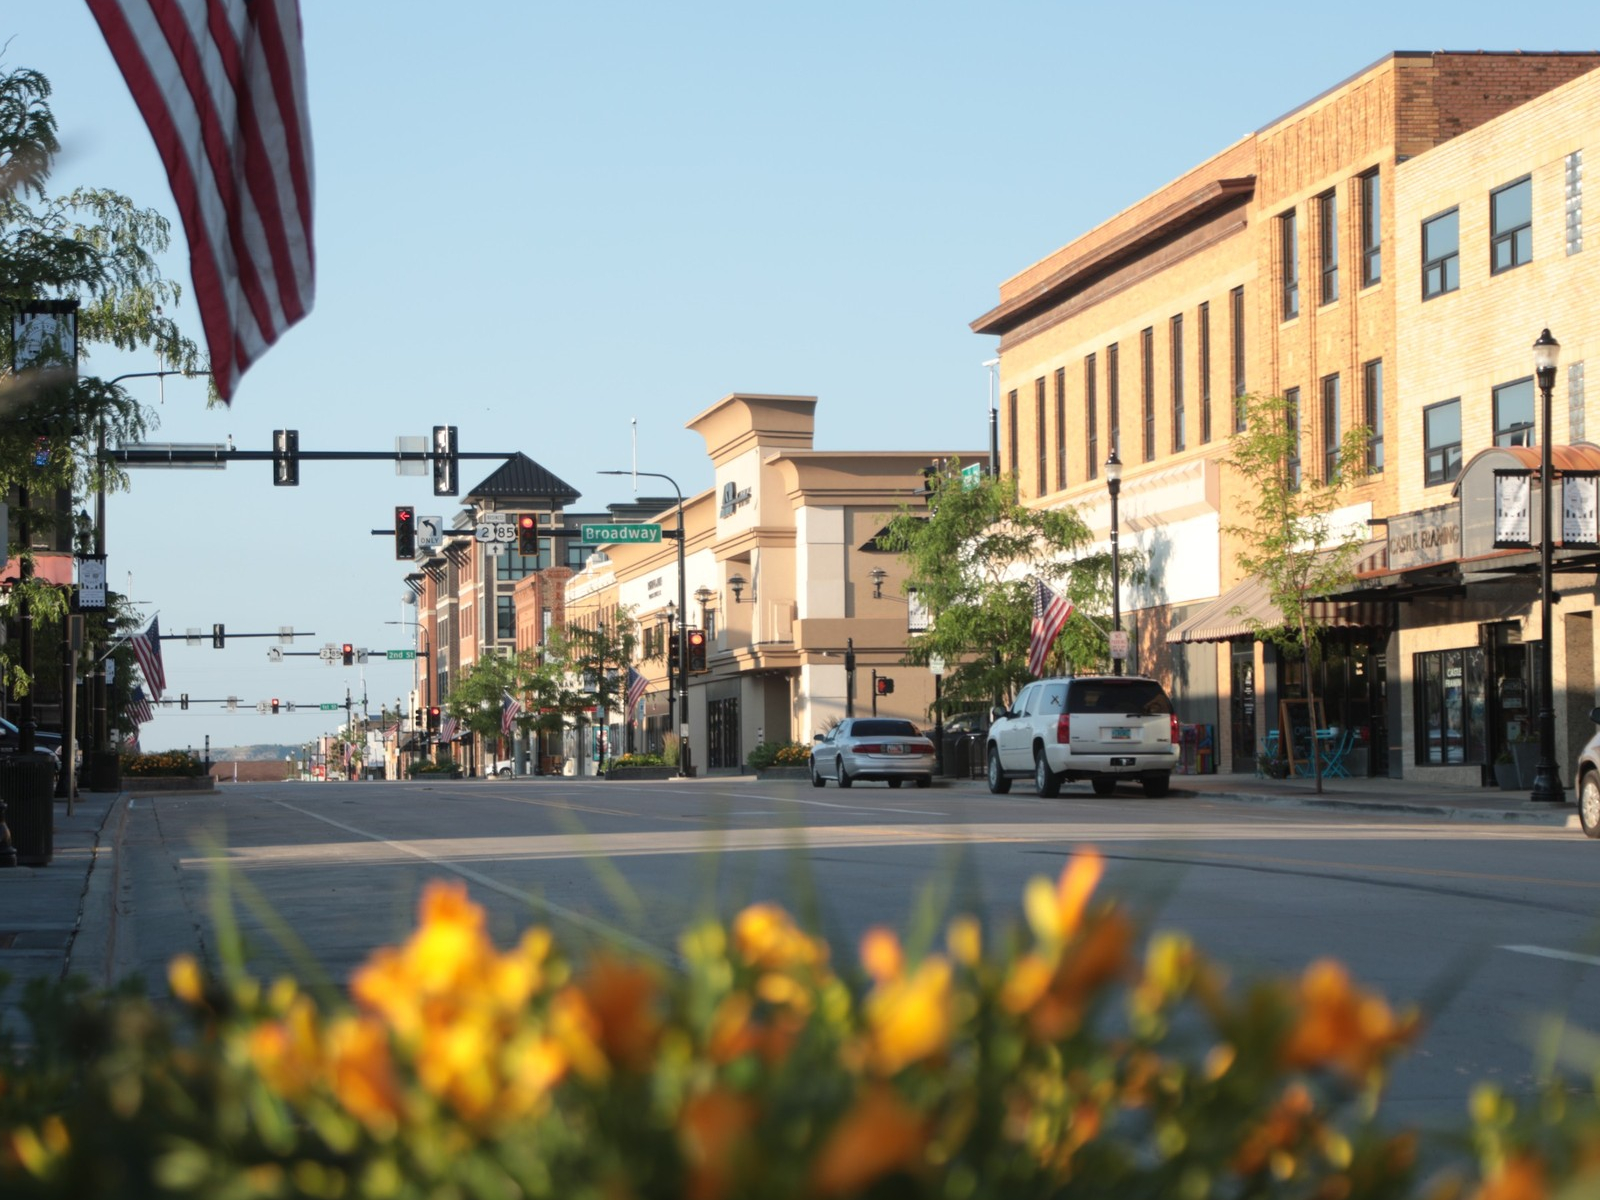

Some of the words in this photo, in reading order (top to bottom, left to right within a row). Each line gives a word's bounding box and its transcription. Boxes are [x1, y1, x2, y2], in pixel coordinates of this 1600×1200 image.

[481, 527, 489, 538] 2
[498, 527, 514, 538] 85
[585, 527, 657, 541] Broadway
[1390, 533, 1418, 555] CASTLE
[1421, 525, 1459, 549] FRAMING
[389, 651, 403, 659] 2nd
[406, 651, 414, 659] St
